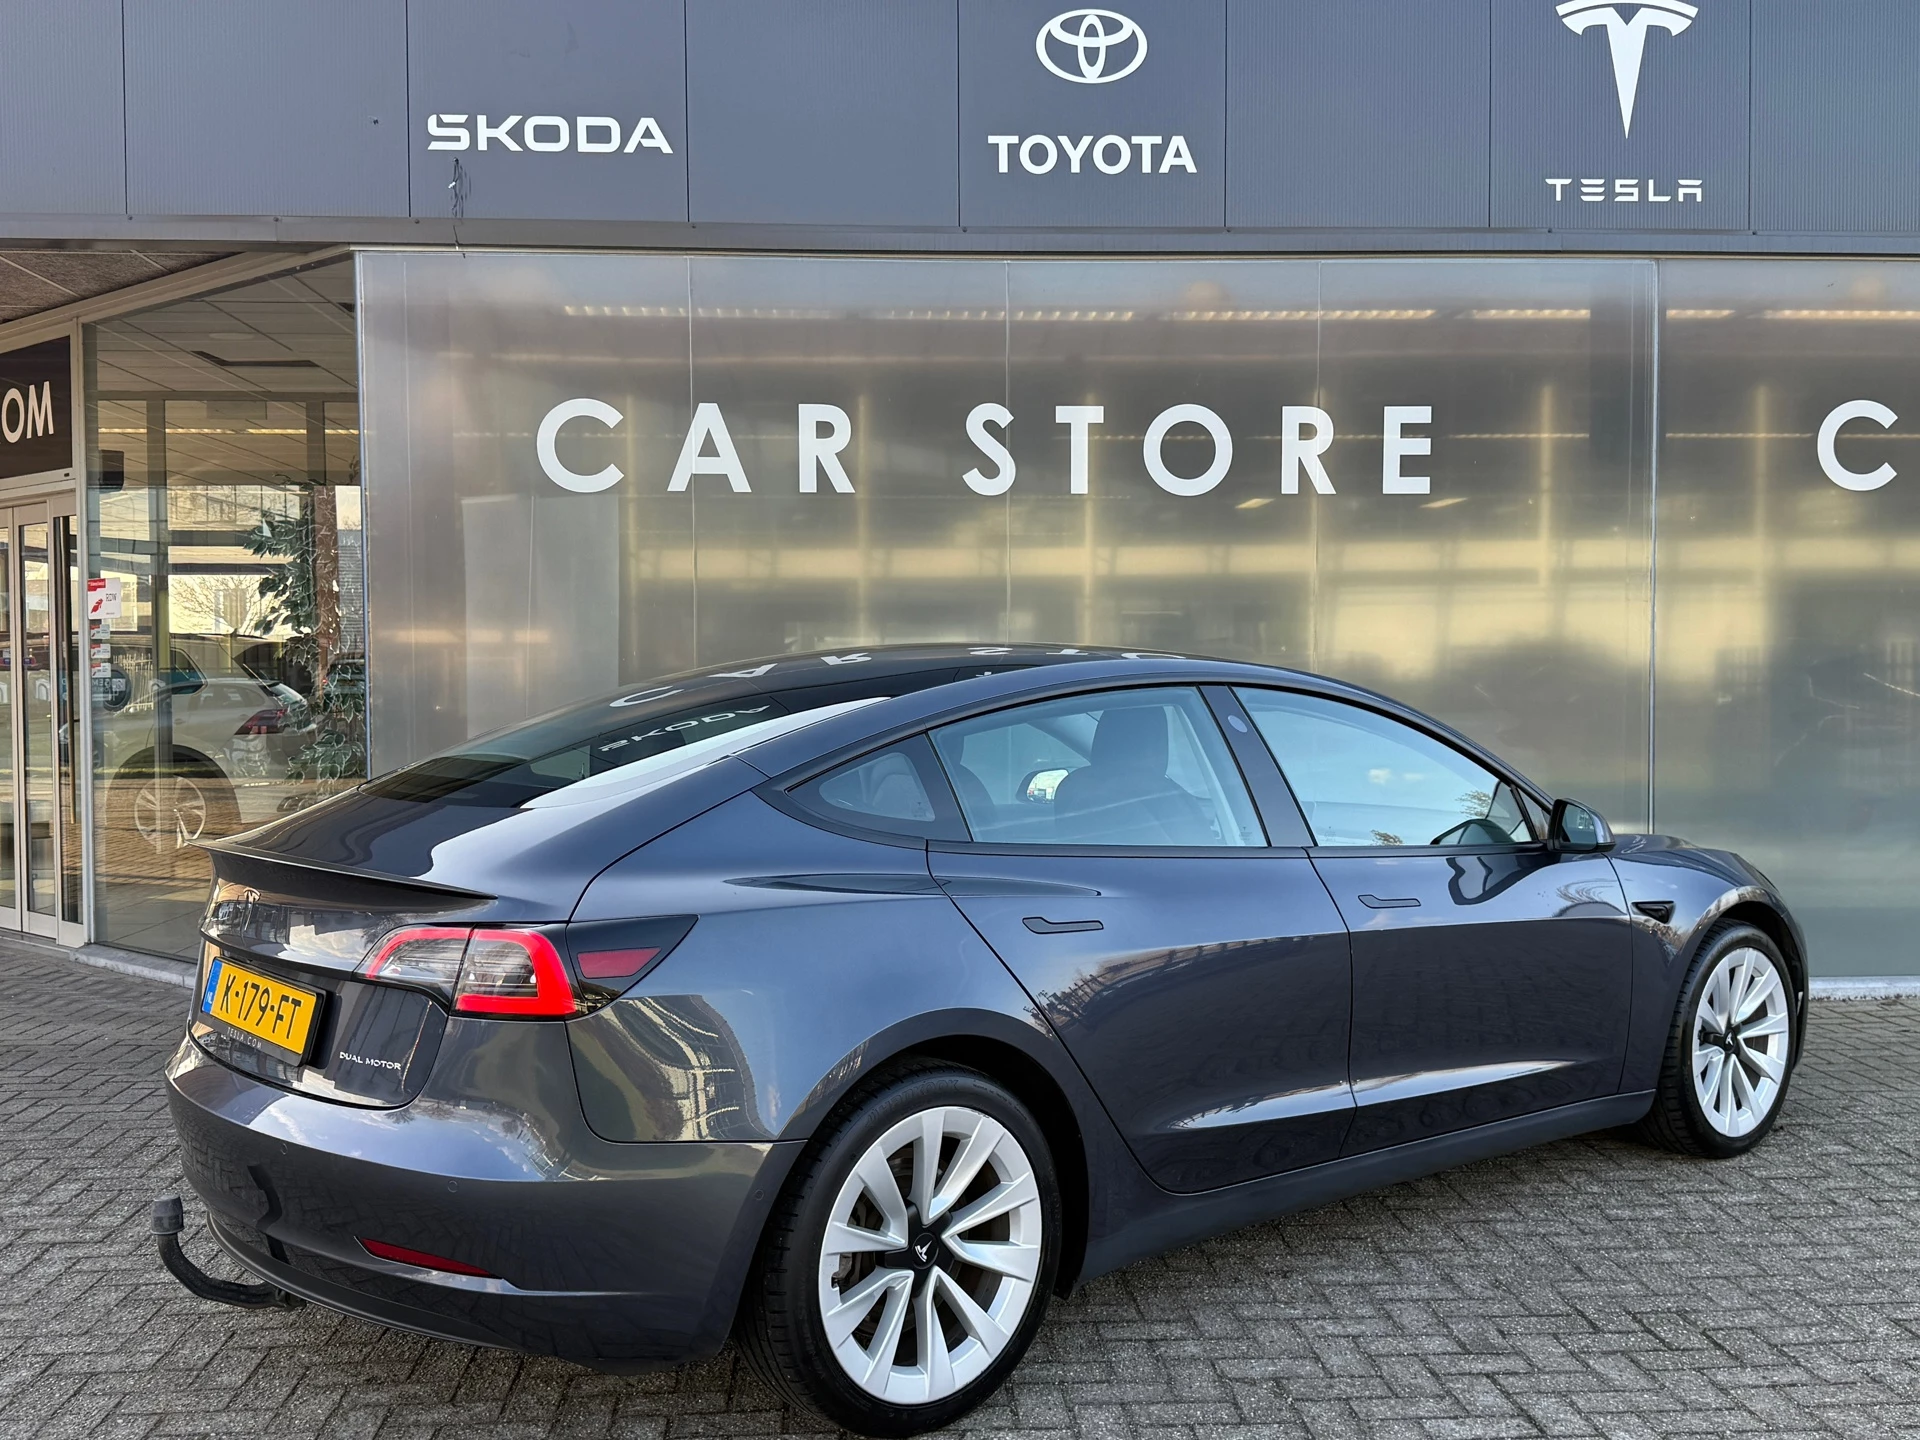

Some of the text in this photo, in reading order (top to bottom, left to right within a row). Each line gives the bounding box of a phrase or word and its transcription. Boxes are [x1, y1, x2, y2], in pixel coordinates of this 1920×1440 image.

[427, 113, 674, 155] SKODA
[987, 134, 1198, 175] TOYOTA
[1545, 178, 1703, 203] TESLA
[536, 398, 1432, 497] CAR STORE
[1817, 399, 1899, 491] C
[220, 973, 302, 1040] K-179-FT
[339, 1051, 402, 1071] DUAL MOTOR
